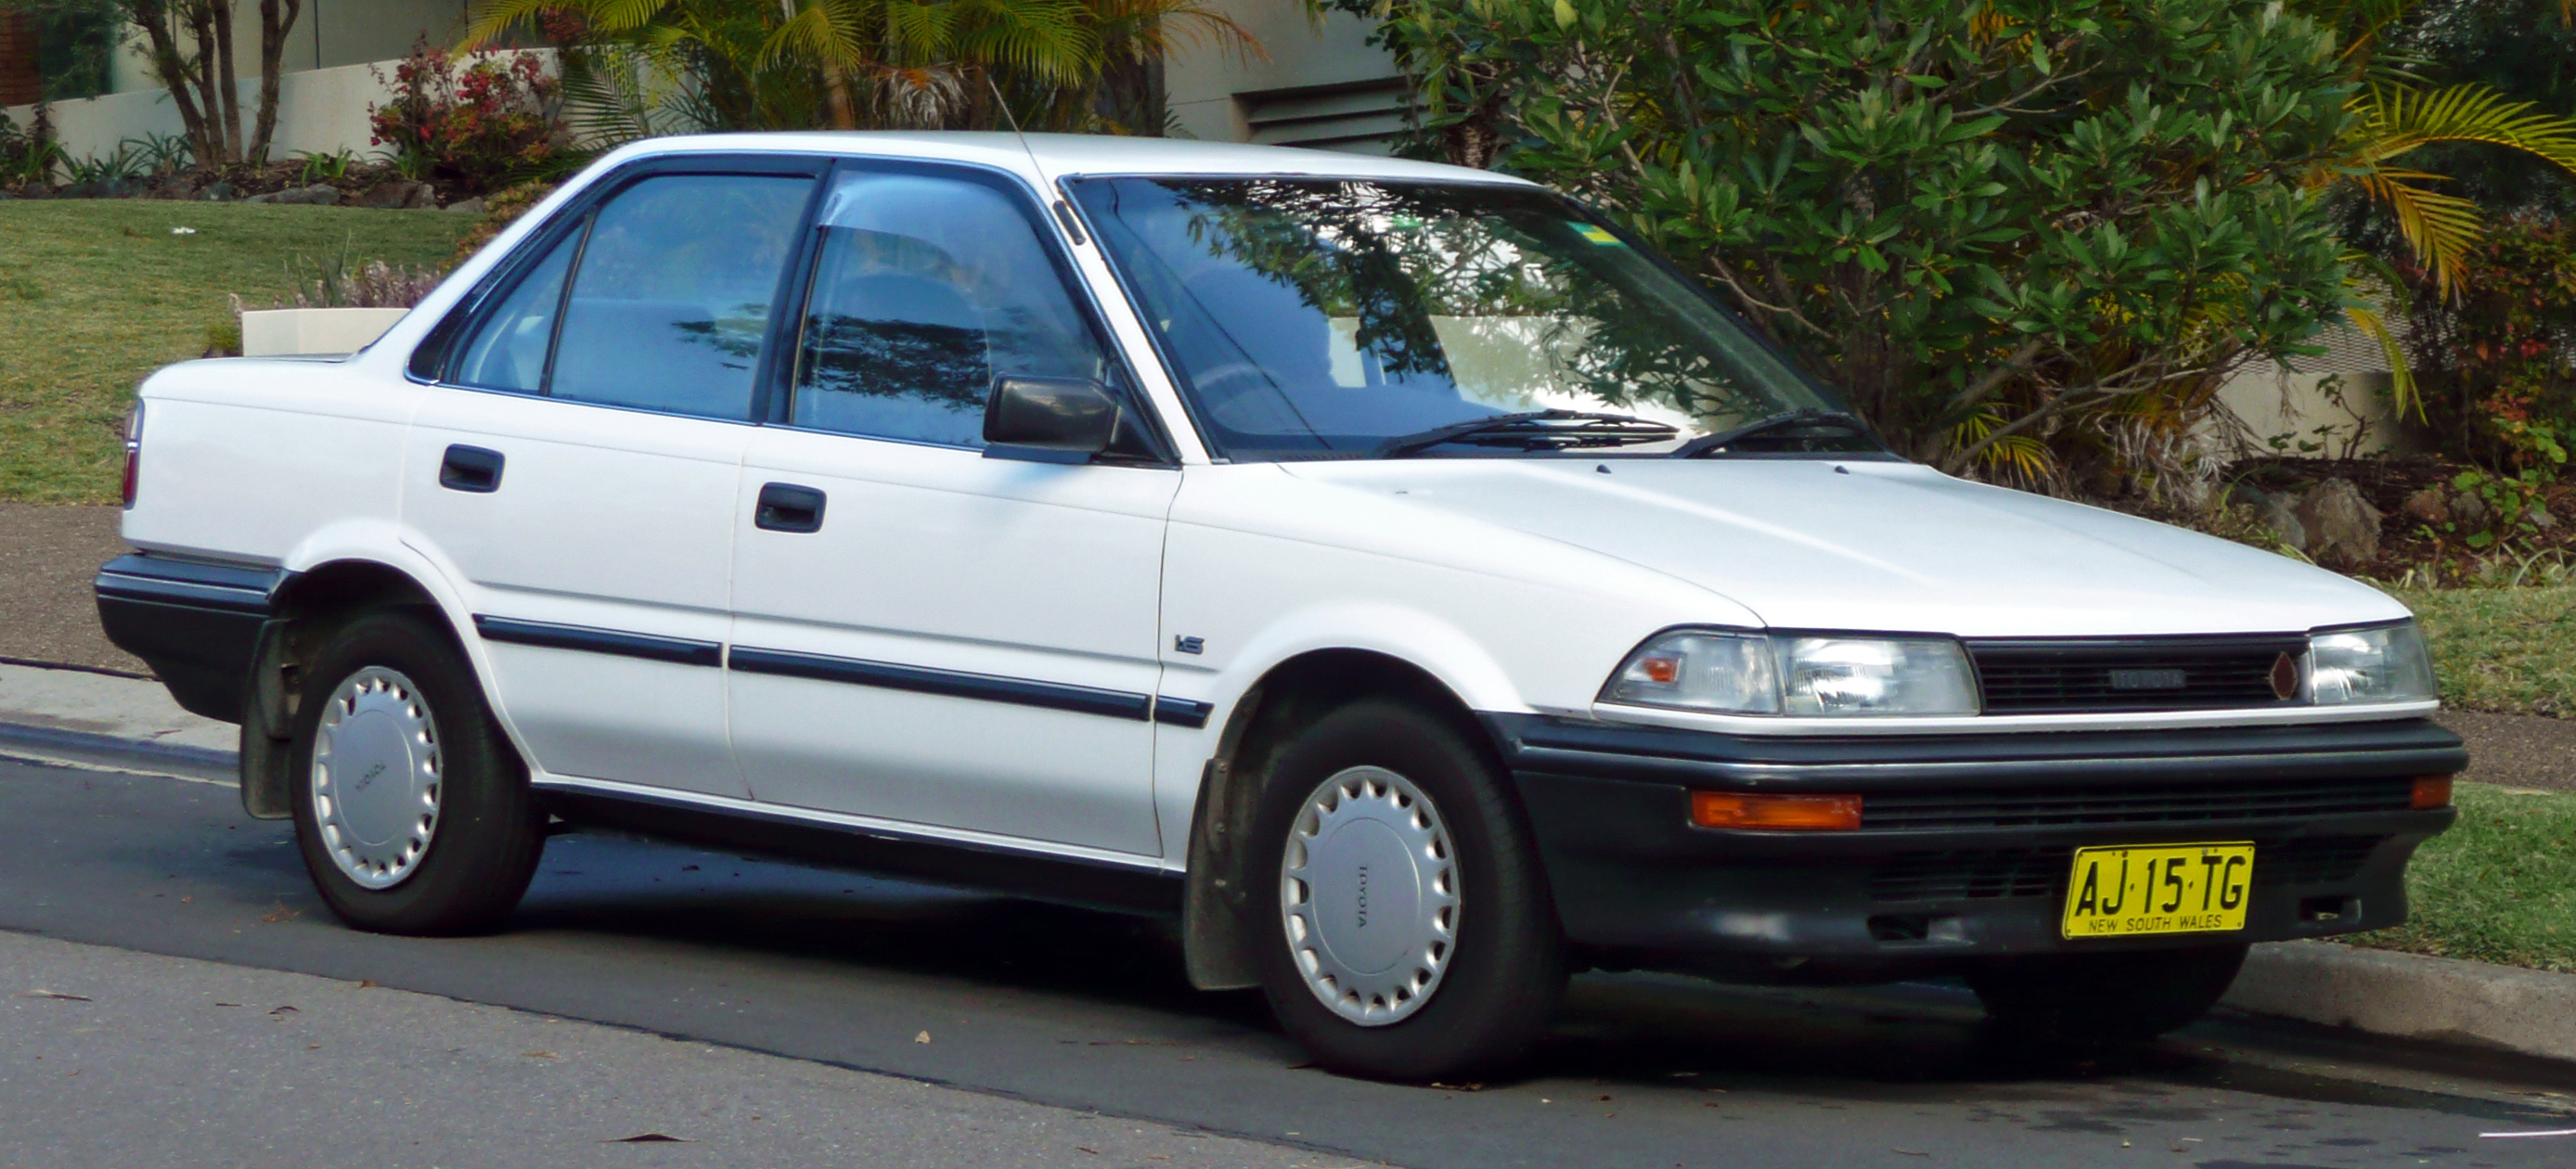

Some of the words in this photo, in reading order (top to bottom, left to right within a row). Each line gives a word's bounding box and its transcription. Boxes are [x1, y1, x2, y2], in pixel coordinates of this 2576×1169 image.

[1359, 866, 1368, 928] TOYOTA
[2088, 918, 2119, 932] NEW
[2126, 916, 2171, 931] SOUTH
[2180, 914, 2222, 928] WALES
